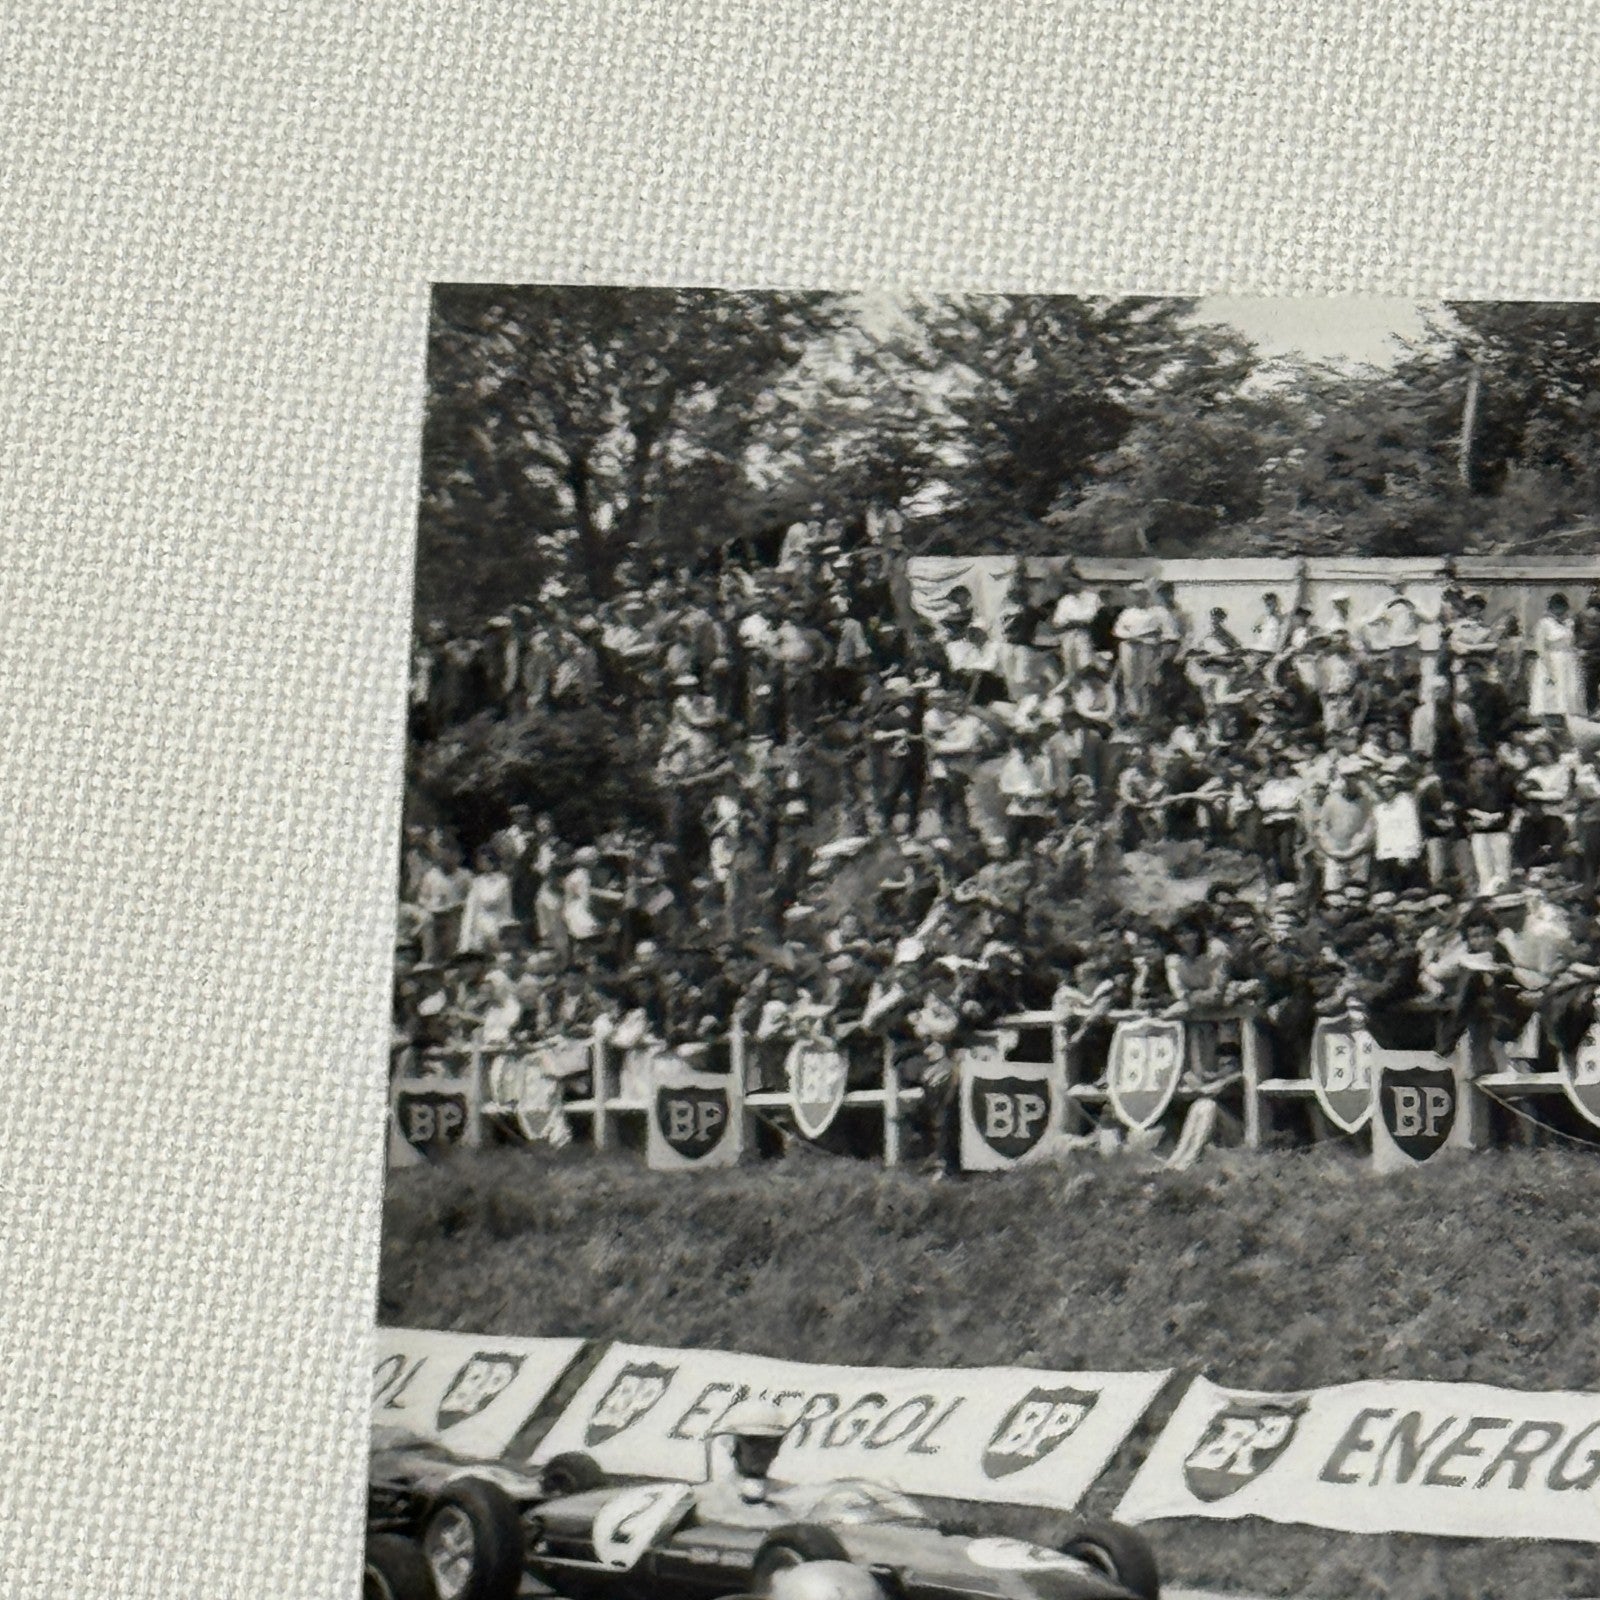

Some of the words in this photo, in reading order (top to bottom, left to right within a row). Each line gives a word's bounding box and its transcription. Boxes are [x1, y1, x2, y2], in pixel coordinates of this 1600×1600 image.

[1117, 1036, 1173, 1093] BP
[408, 1101, 463, 1142] BP
[669, 1099, 723, 1142] BP
[984, 1092, 1046, 1139] BP
[1390, 1085, 1452, 1137] BP
[441, 1360, 514, 1413] BP
[592, 1374, 666, 1429] BP
[993, 1400, 1086, 1458] BP
[1185, 1415, 1293, 1475] BP
